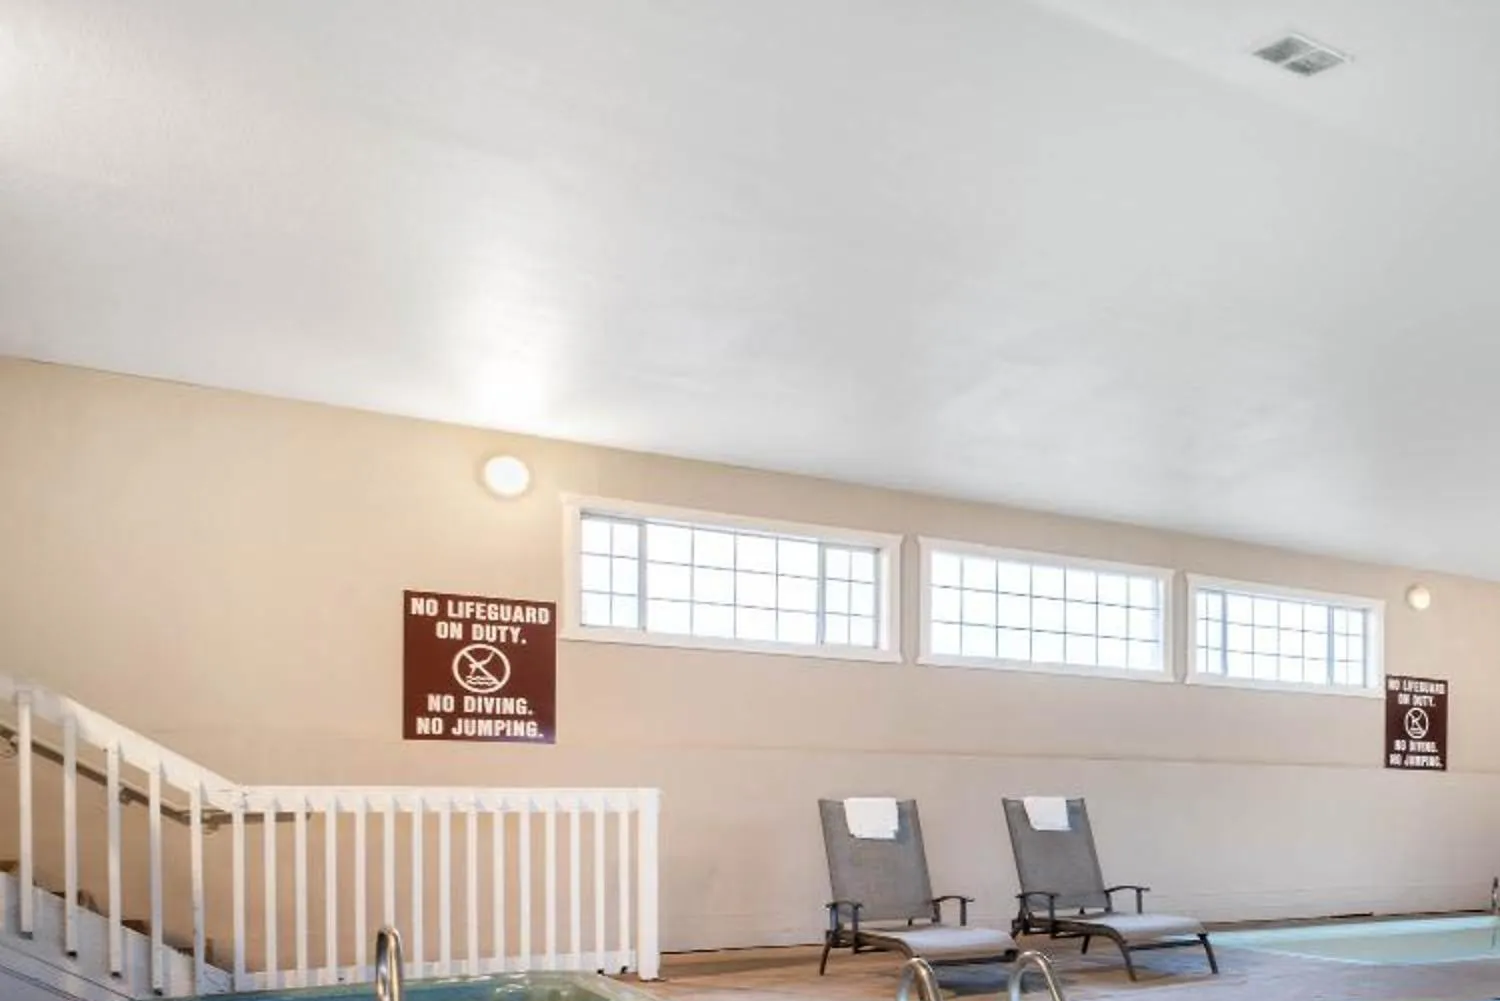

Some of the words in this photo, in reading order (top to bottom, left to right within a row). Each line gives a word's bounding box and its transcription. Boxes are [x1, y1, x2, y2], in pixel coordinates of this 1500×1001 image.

[411, 597, 438, 616] NO
[448, 599, 550, 625] LIFEGUARD
[436, 621, 463, 639] ON
[472, 623, 527, 644] DUTY.
[427, 694, 454, 712] NO
[464, 696, 533, 715] DIVING.
[416, 717, 443, 735] NO
[452, 719, 544, 737] JUMPING.
